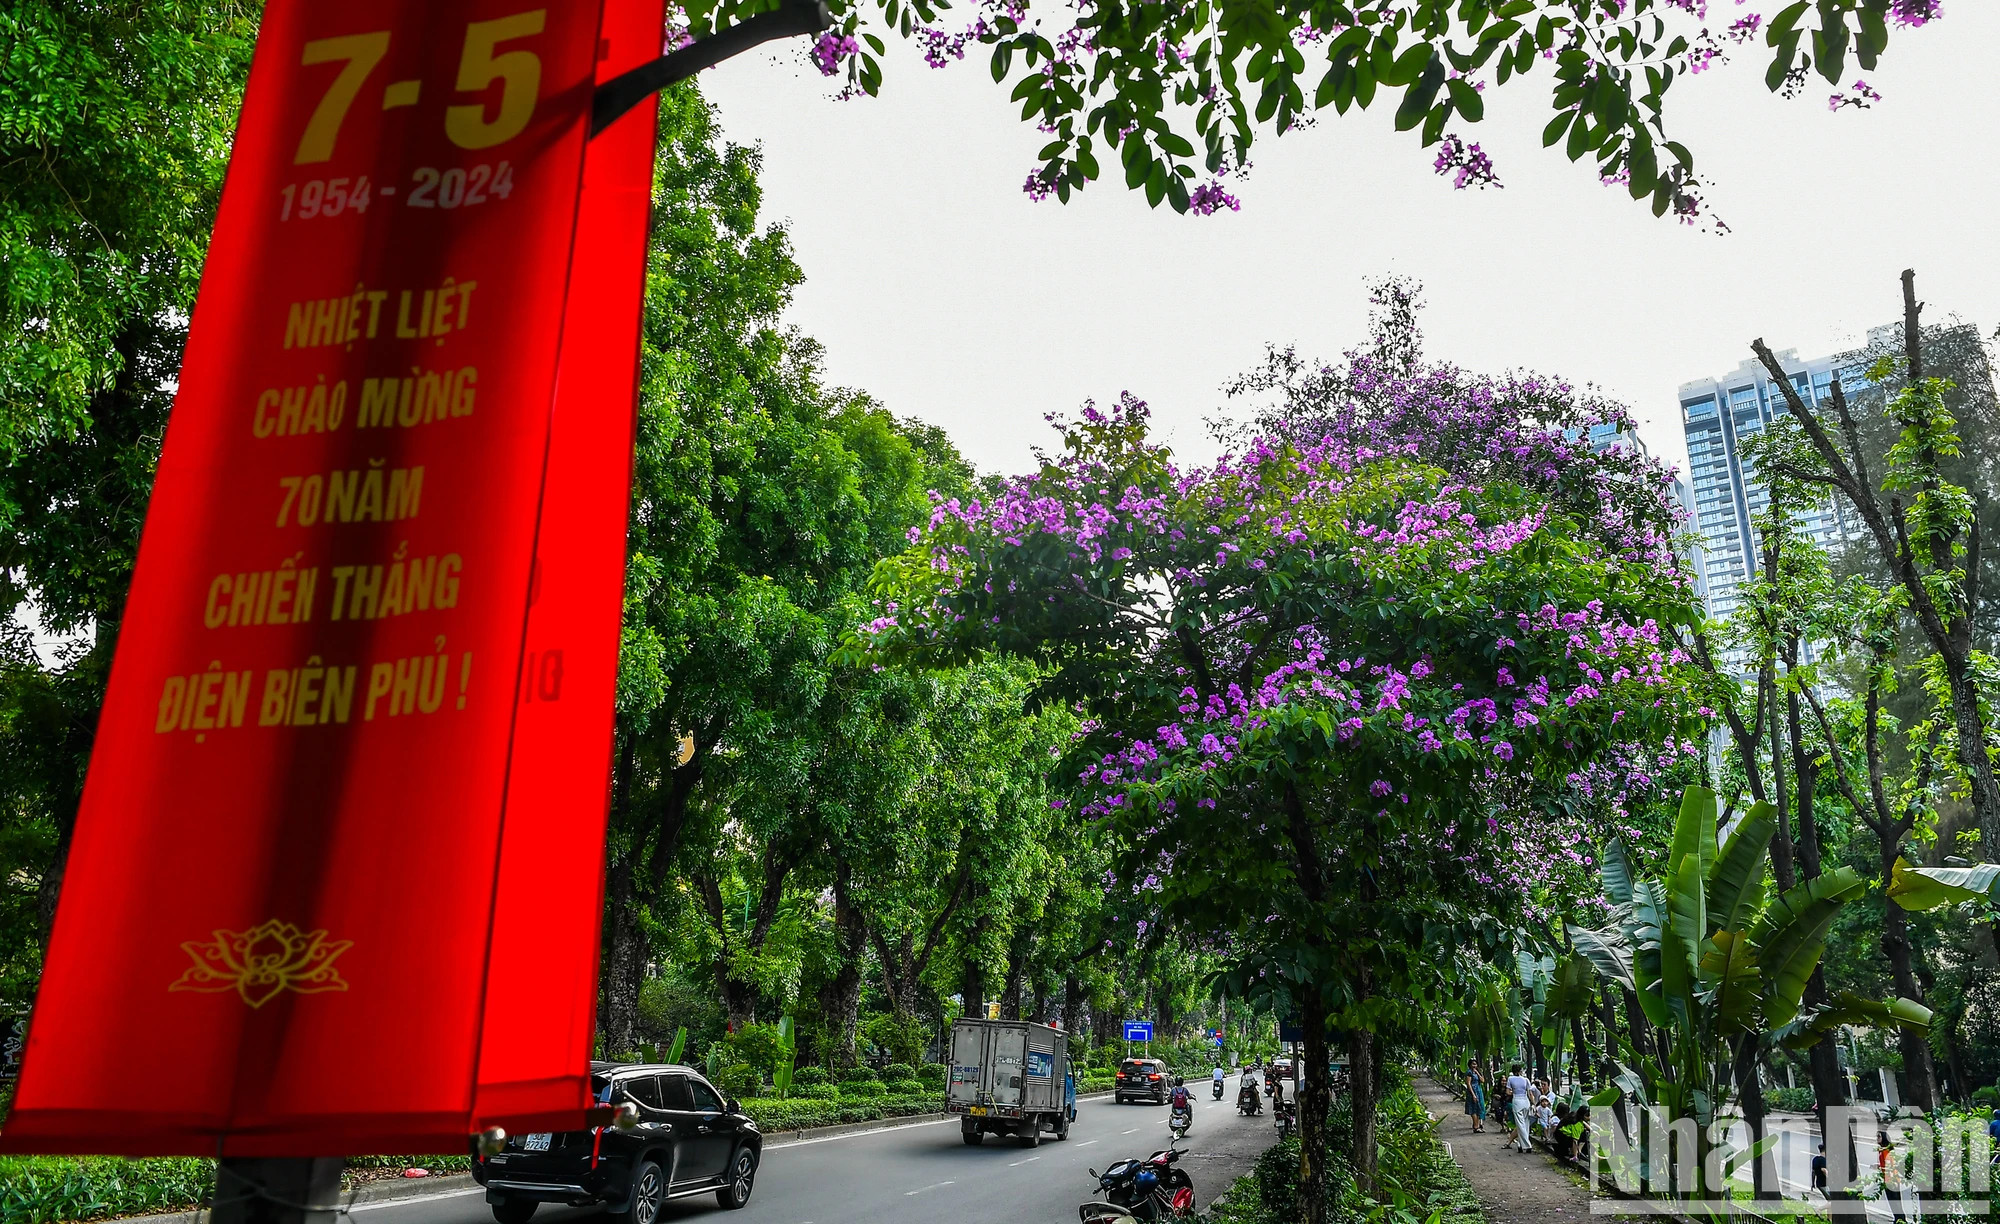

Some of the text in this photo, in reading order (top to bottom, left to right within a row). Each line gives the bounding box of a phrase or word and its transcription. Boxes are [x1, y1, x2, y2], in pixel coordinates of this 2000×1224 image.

[293, 31, 391, 165] 7
[444, 8, 547, 150] 5
[280, 175, 371, 222] 1954
[406, 160, 514, 209] 2024
[284, 276, 477, 352] NHIỆT LIỆT
[252, 366, 478, 438] CHÀO MỪNG
[276, 457, 425, 528] 70 NĂM
[204, 540, 463, 629] CHIẾN THẮNG
[154, 659, 253, 744] ĐIỆN
[258, 655, 357, 727] BIÊN
